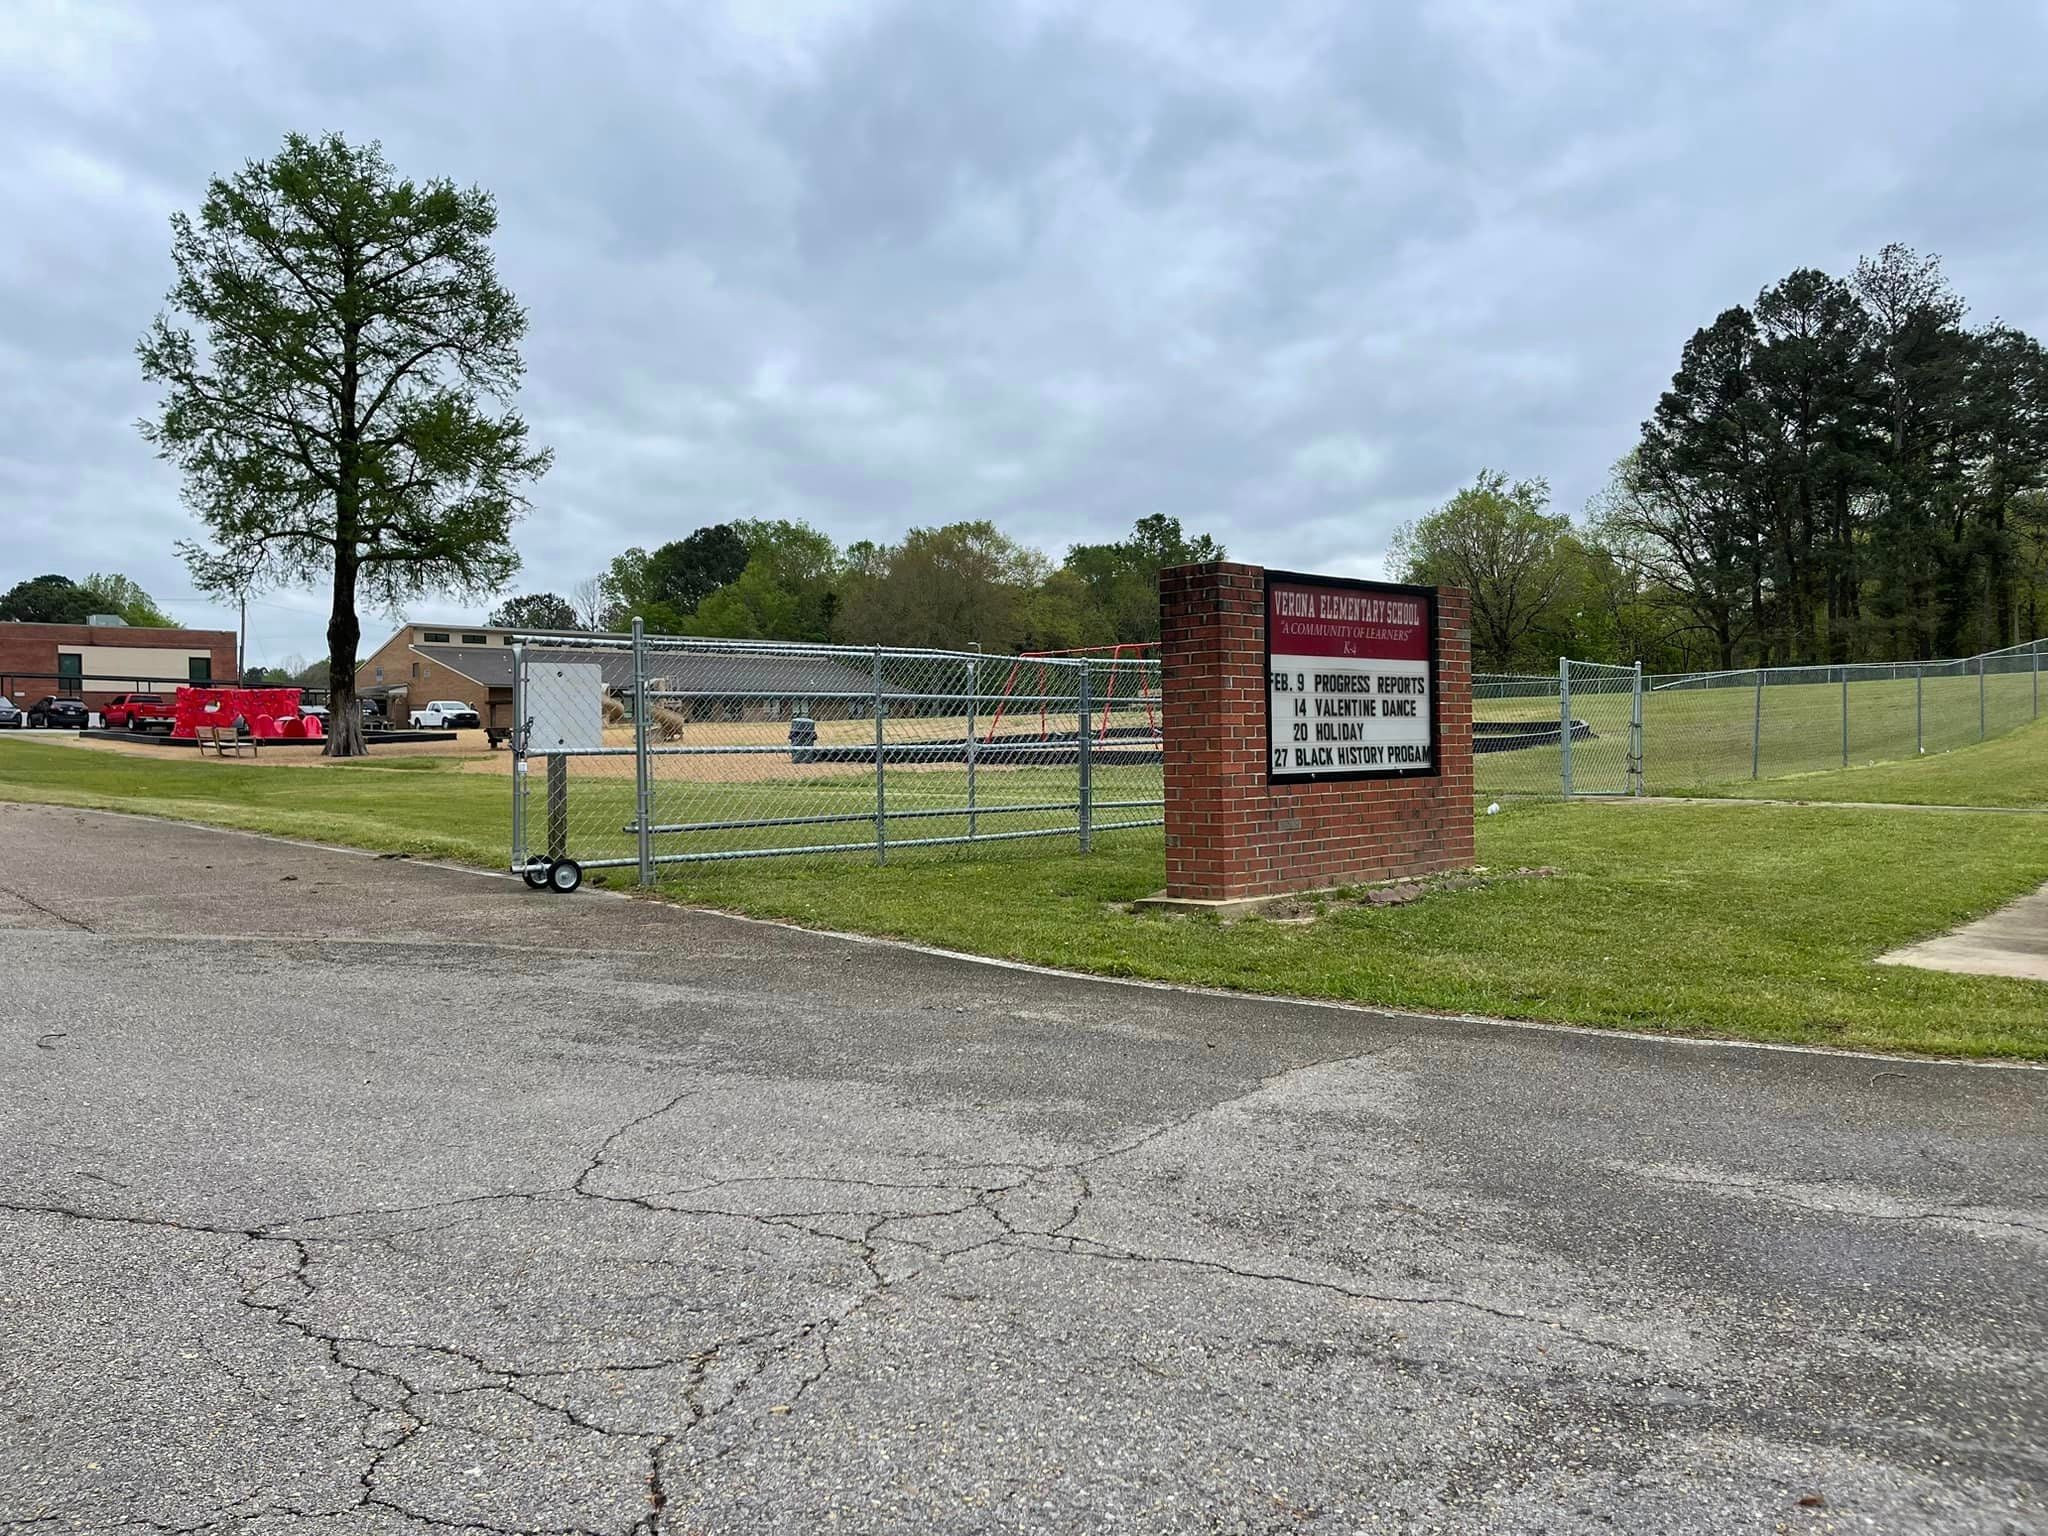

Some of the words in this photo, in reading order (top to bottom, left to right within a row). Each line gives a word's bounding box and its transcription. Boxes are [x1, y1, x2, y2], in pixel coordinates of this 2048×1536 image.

[1275, 591, 1315, 618] VERONA
[1320, 595, 1385, 624] ELEMENTARY
[1387, 600, 1420, 626] SCHOOL
[1291, 622, 1352, 638] COMMUNITY
[1353, 627, 1366, 639] OF
[1297, 673, 1305, 692] 9
[1314, 674, 1371, 694] PROGRESS
[1377, 676, 1425, 695] REPORTS
[1295, 698, 1307, 717] 14
[1315, 699, 1376, 717] VALENTINE
[1382, 700, 1417, 717] DANCE
[1293, 723, 1308, 742] 20
[1316, 723, 1364, 742] HOLIDAY
[1274, 749, 1288, 768] 27
[1295, 747, 1334, 767] BLACK
[1338, 746, 1384, 765] HISTORY
[1388, 745, 1432, 763] PROGAM
